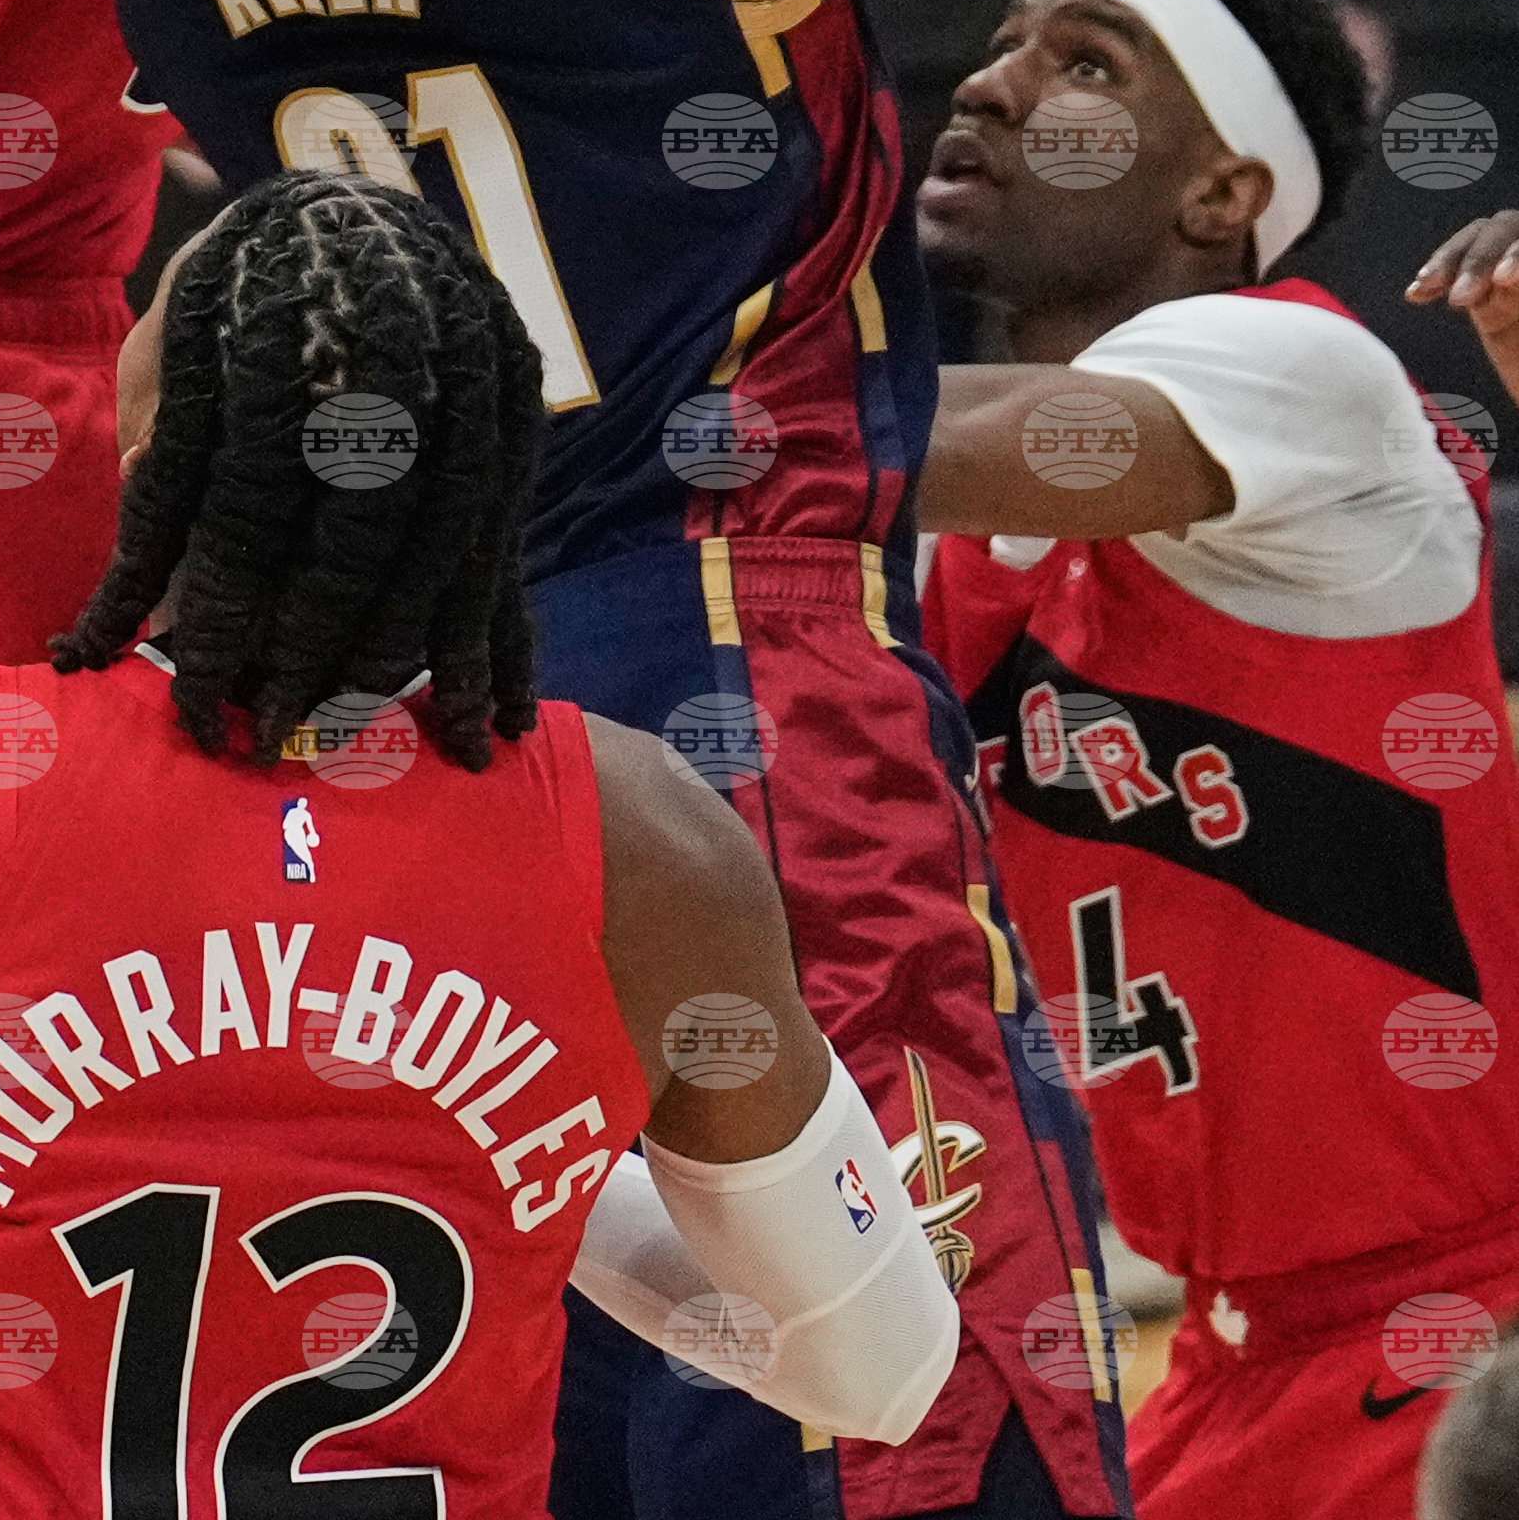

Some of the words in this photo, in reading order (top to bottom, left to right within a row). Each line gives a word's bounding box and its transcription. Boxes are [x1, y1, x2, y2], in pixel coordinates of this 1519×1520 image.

[286, 863, 308, 880] NBA
[1070, 884, 1200, 1096] 4
[50, 1182, 475, 1520] 12
